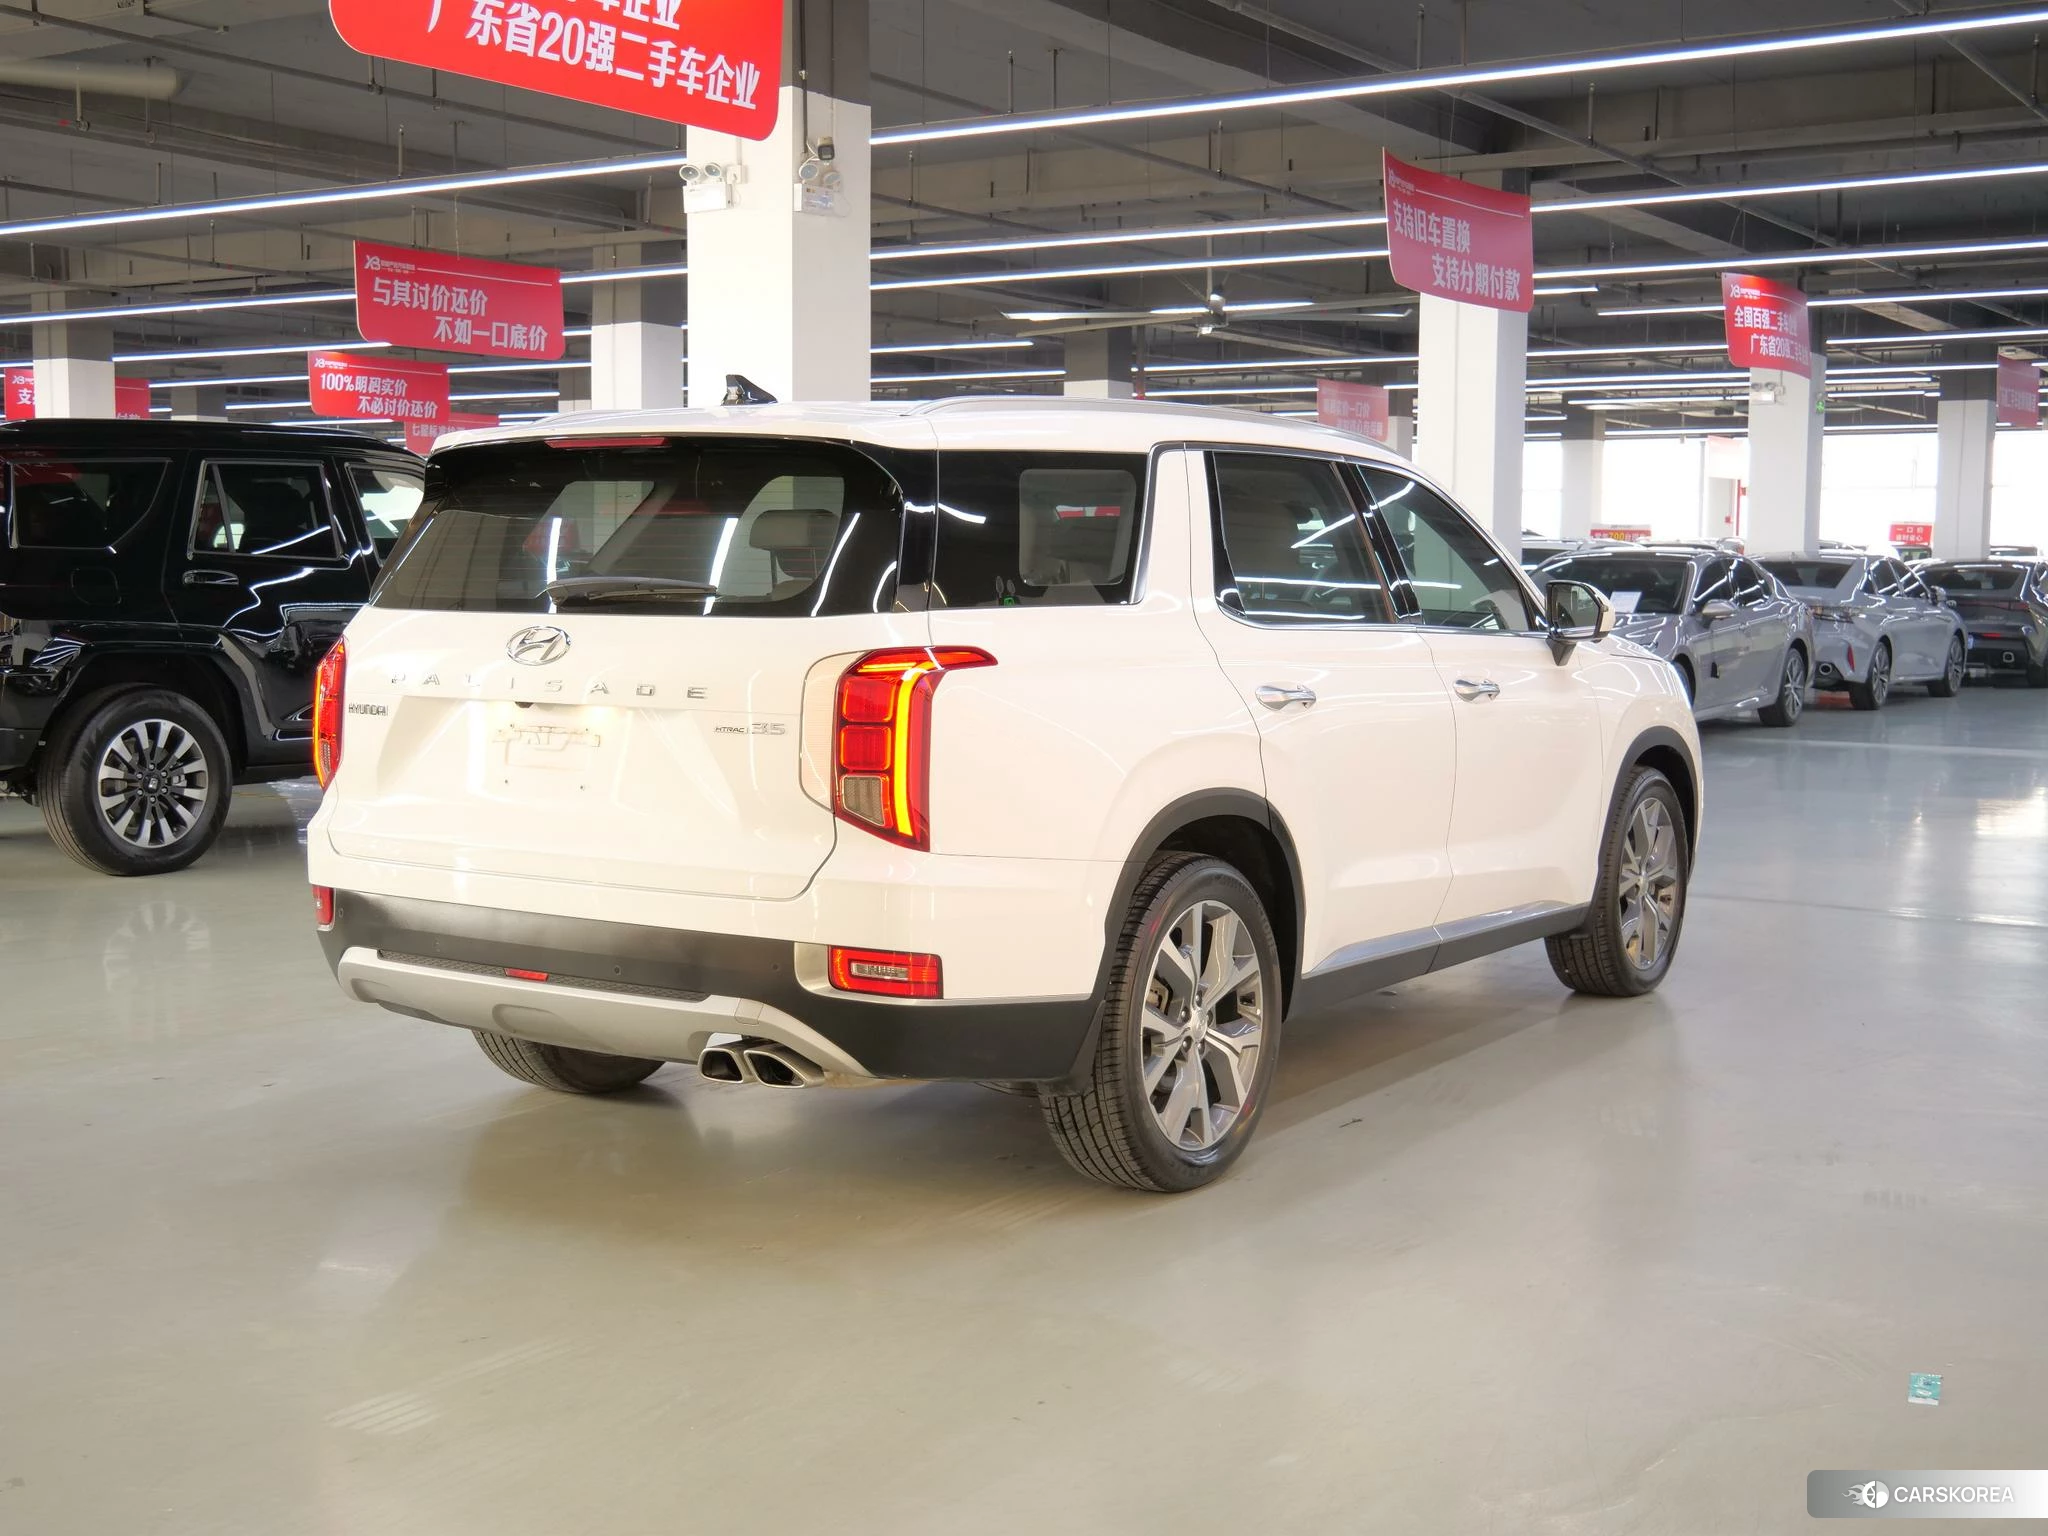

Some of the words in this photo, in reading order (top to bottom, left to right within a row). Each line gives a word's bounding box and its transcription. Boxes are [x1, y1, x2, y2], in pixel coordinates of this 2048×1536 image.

[1393, 198, 1471, 254] 支持旧车置换
[1432, 252, 1520, 301] 支持分期付款
[373, 277, 488, 317] 与其讨价还价
[433, 316, 548, 352] 不如一口底价
[16, 388, 35, 405] 支
[320, 372, 408, 397] 100%明码实价
[357, 396, 438, 419] 不必讨价还价
[391, 673, 709, 699] PALISADE
[348, 703, 389, 716] HYUNDAI
